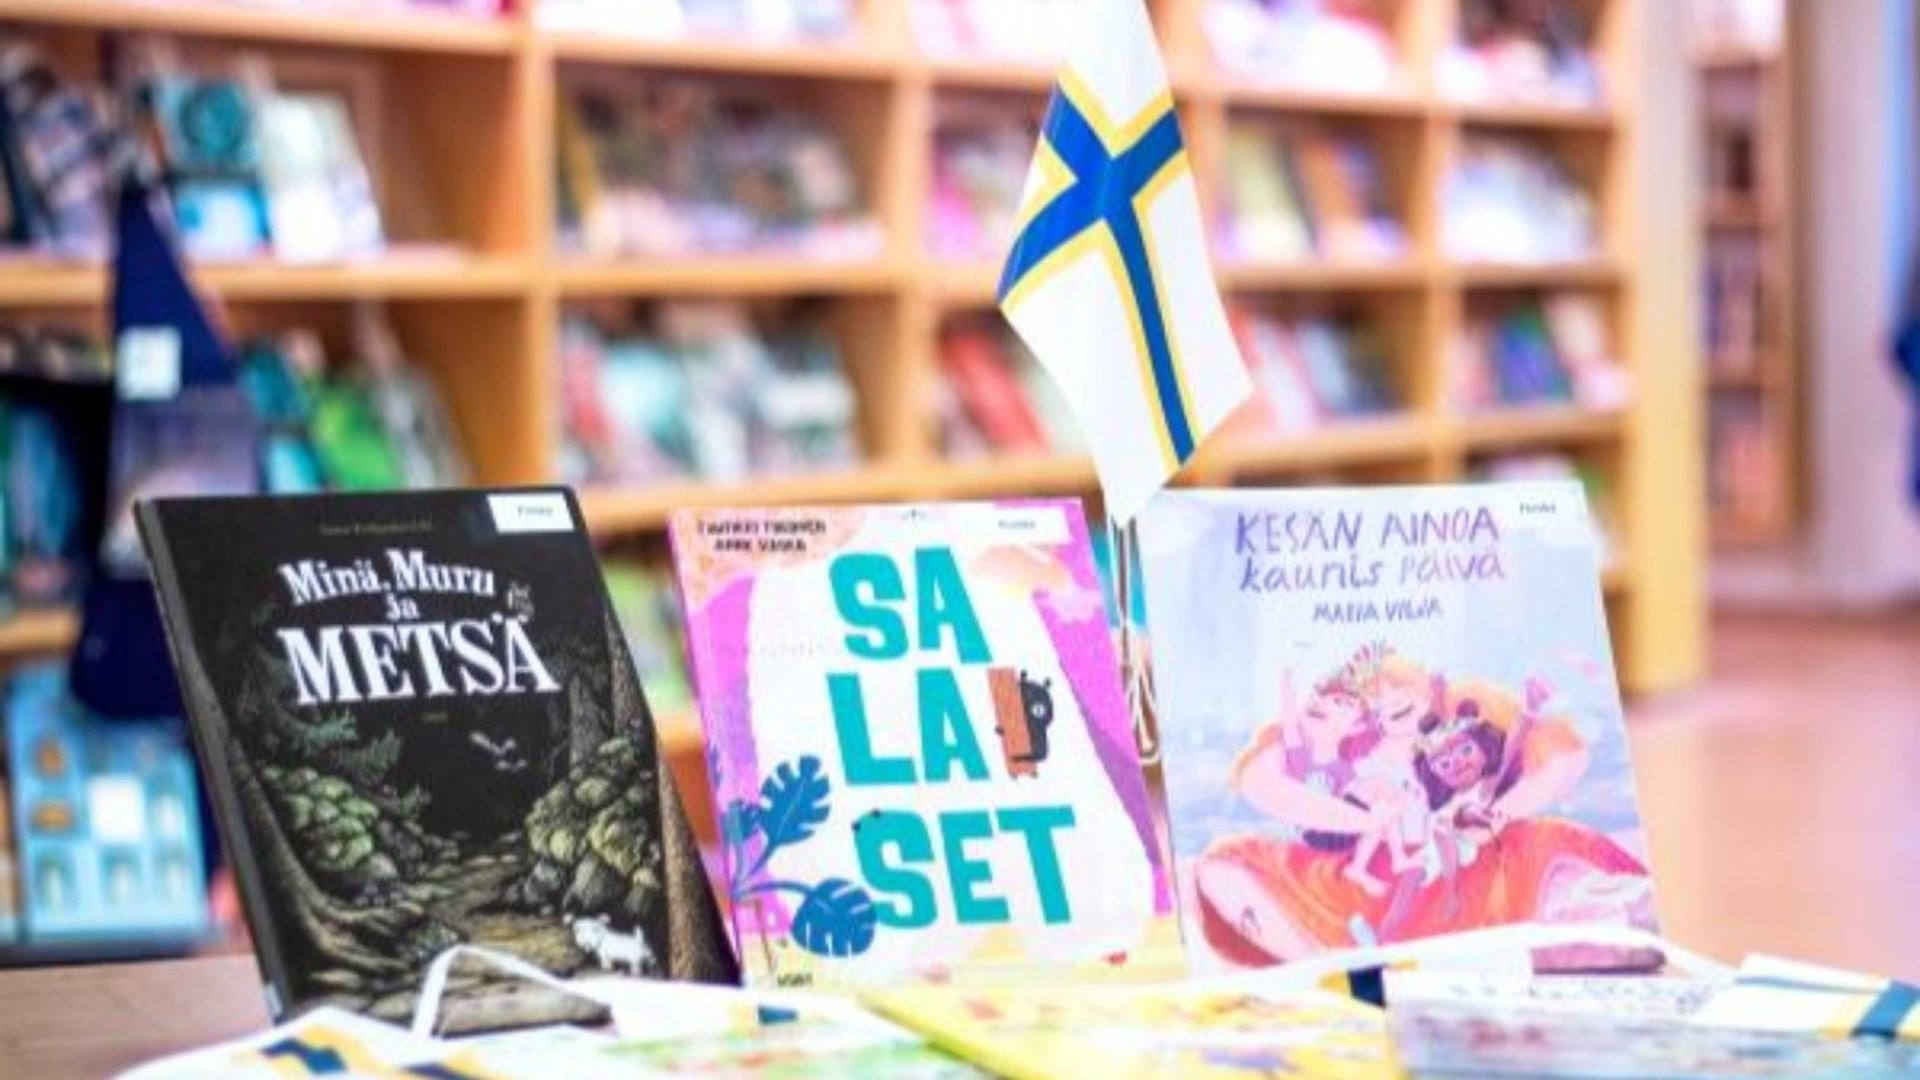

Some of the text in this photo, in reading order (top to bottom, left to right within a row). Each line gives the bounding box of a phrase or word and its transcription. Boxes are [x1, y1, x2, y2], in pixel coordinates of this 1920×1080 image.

[385, 547, 496, 597] Muru
[1380, 505, 1500, 548] AINOA
[828, 544, 993, 664] SA
[276, 611, 562, 707] METSÄ
[853, 804, 1076, 930] SET
